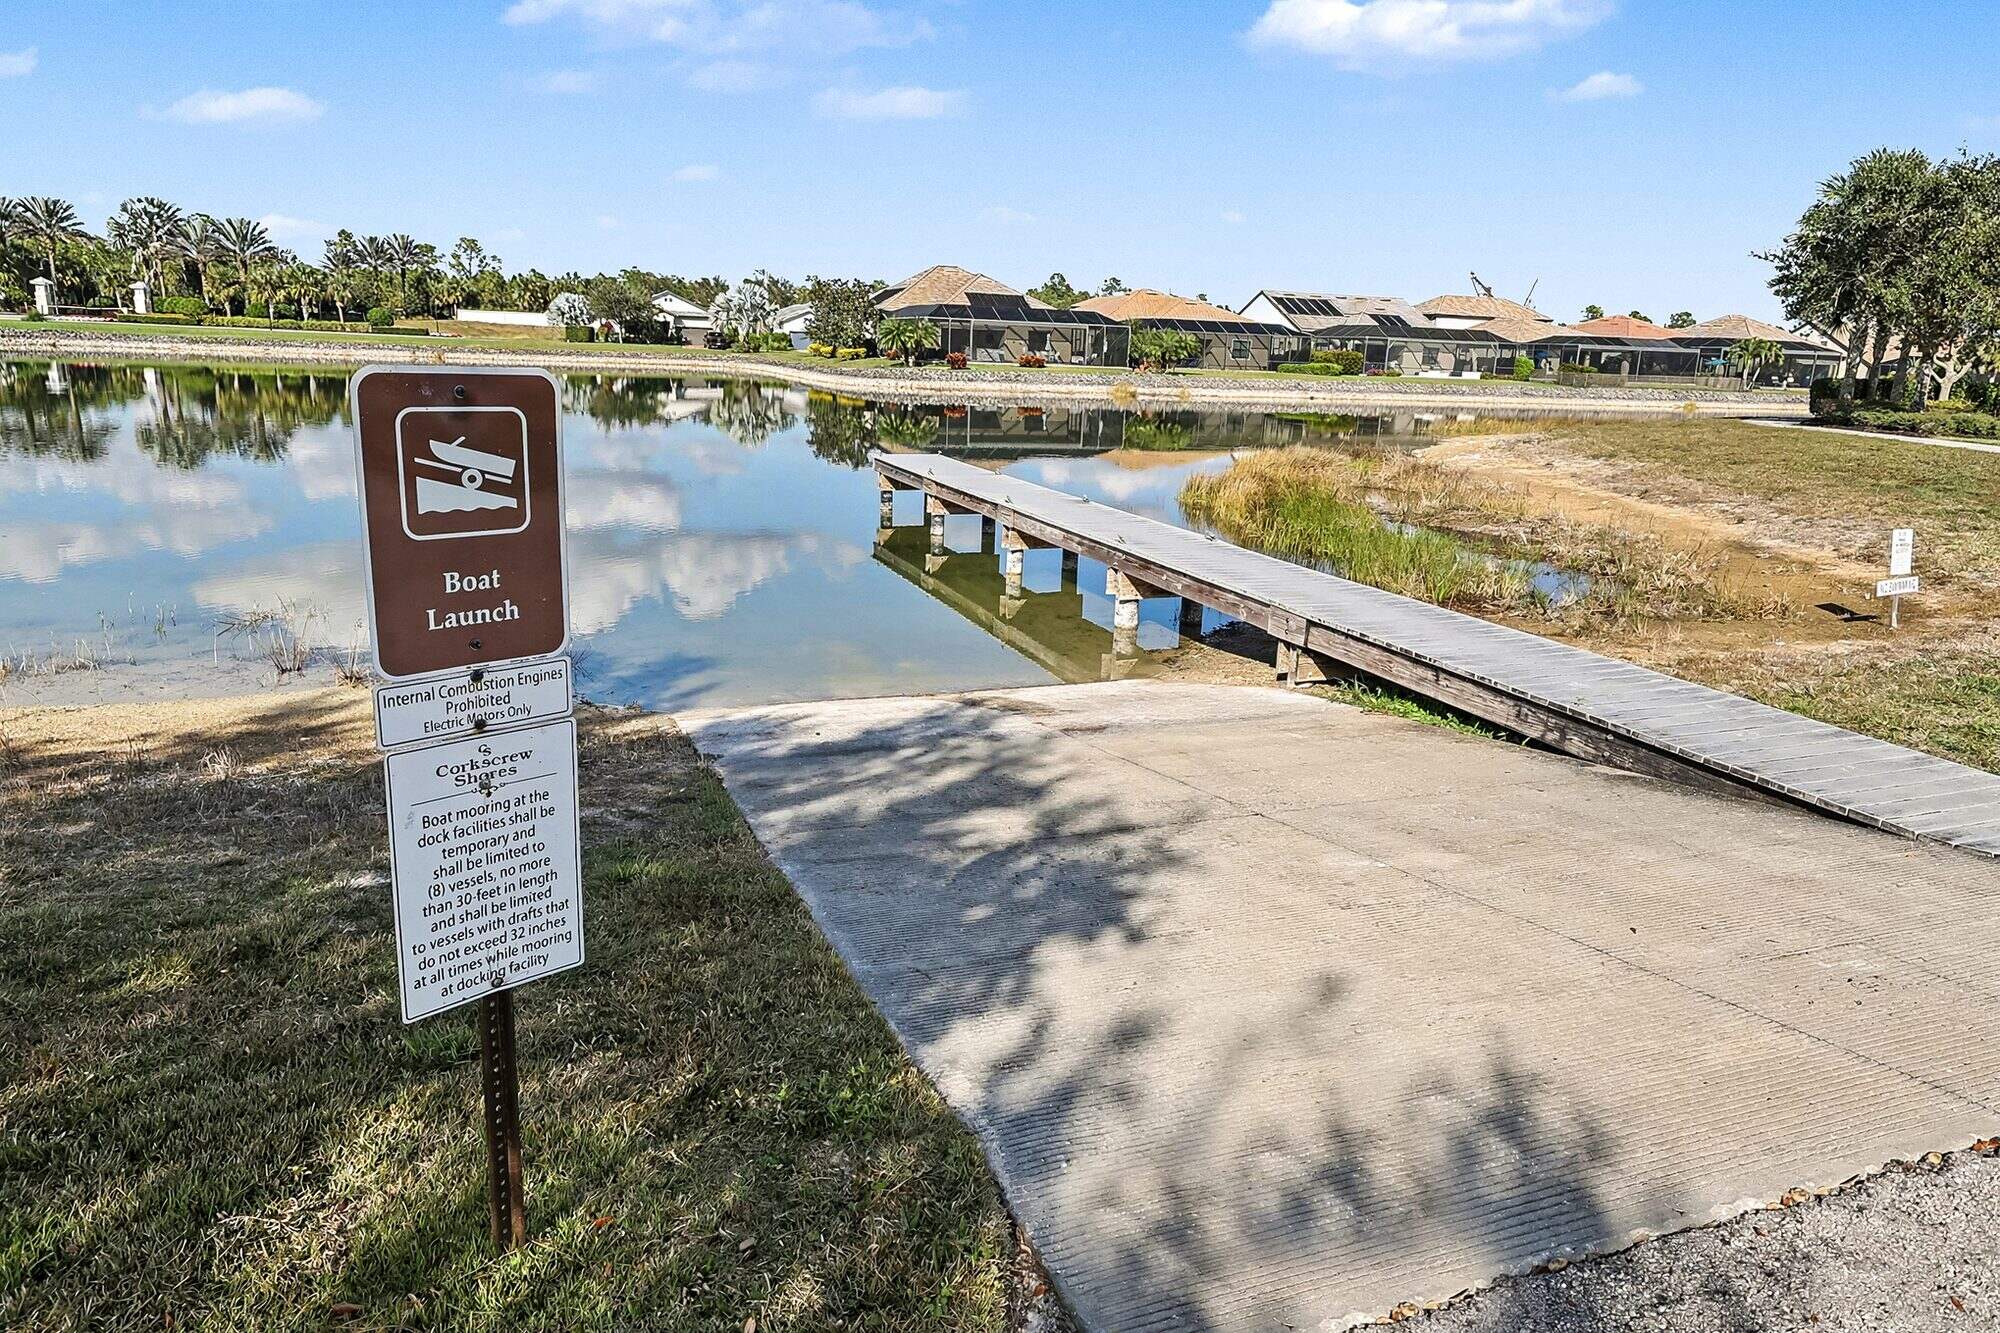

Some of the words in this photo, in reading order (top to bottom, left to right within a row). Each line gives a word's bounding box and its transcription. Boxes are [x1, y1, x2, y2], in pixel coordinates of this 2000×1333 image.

[443, 569, 501, 594] Boat
[426, 599, 520, 631] Launch
[383, 686, 435, 709] Internal
[438, 675, 515, 699] Combustion
[518, 668, 563, 688] Engines
[446, 691, 511, 715] Prohibited
[424, 714, 465, 734] Electric
[466, 707, 505, 724] Motors
[507, 703, 532, 718] Only
[436, 750, 533, 777] Corkscrew
[454, 766, 518, 787] Shores
[417, 829, 450, 849] dock
[453, 818, 506, 840] facilities
[508, 808, 537, 825] shall
[540, 805, 556, 819] be
[422, 811, 453, 830] Boat
[456, 799, 511, 822] mooring
[513, 795, 526, 808] at
[529, 789, 550, 805] the
[433, 861, 463, 880] shall
[466, 856, 483, 871] be
[485, 843, 529, 866] limited
[533, 841, 546, 853] to
[442, 833, 509, 860] temporary
[512, 824, 536, 841] and
[423, 900, 453, 918] than
[456, 887, 501, 908] 30-feet
[504, 881, 516, 894] in
[519, 868, 558, 891] length
[428, 882, 445, 900] (8)
[449, 870, 497, 892] vessels,
[499, 864, 516, 877] no
[519, 856, 551, 873] more
[412, 943, 426, 956] to
[430, 927, 475, 949] vessels
[477, 917, 505, 935] with
[508, 907, 543, 926] drafts
[546, 898, 569, 915] that
[431, 914, 455, 933] and
[459, 904, 488, 924] shall
[491, 898, 507, 914] be
[509, 886, 552, 909] limited
[413, 975, 427, 990] at
[430, 967, 445, 985] all
[448, 958, 483, 977] times
[485, 946, 519, 966] while
[521, 930, 572, 953] mooring
[418, 952, 436, 971] do
[439, 947, 461, 965] not
[464, 931, 508, 956] exceed
[511, 927, 525, 941] 32
[528, 915, 567, 935] inches
[441, 983, 454, 998] at
[457, 967, 506, 991] docking
[509, 952, 550, 975] facility
